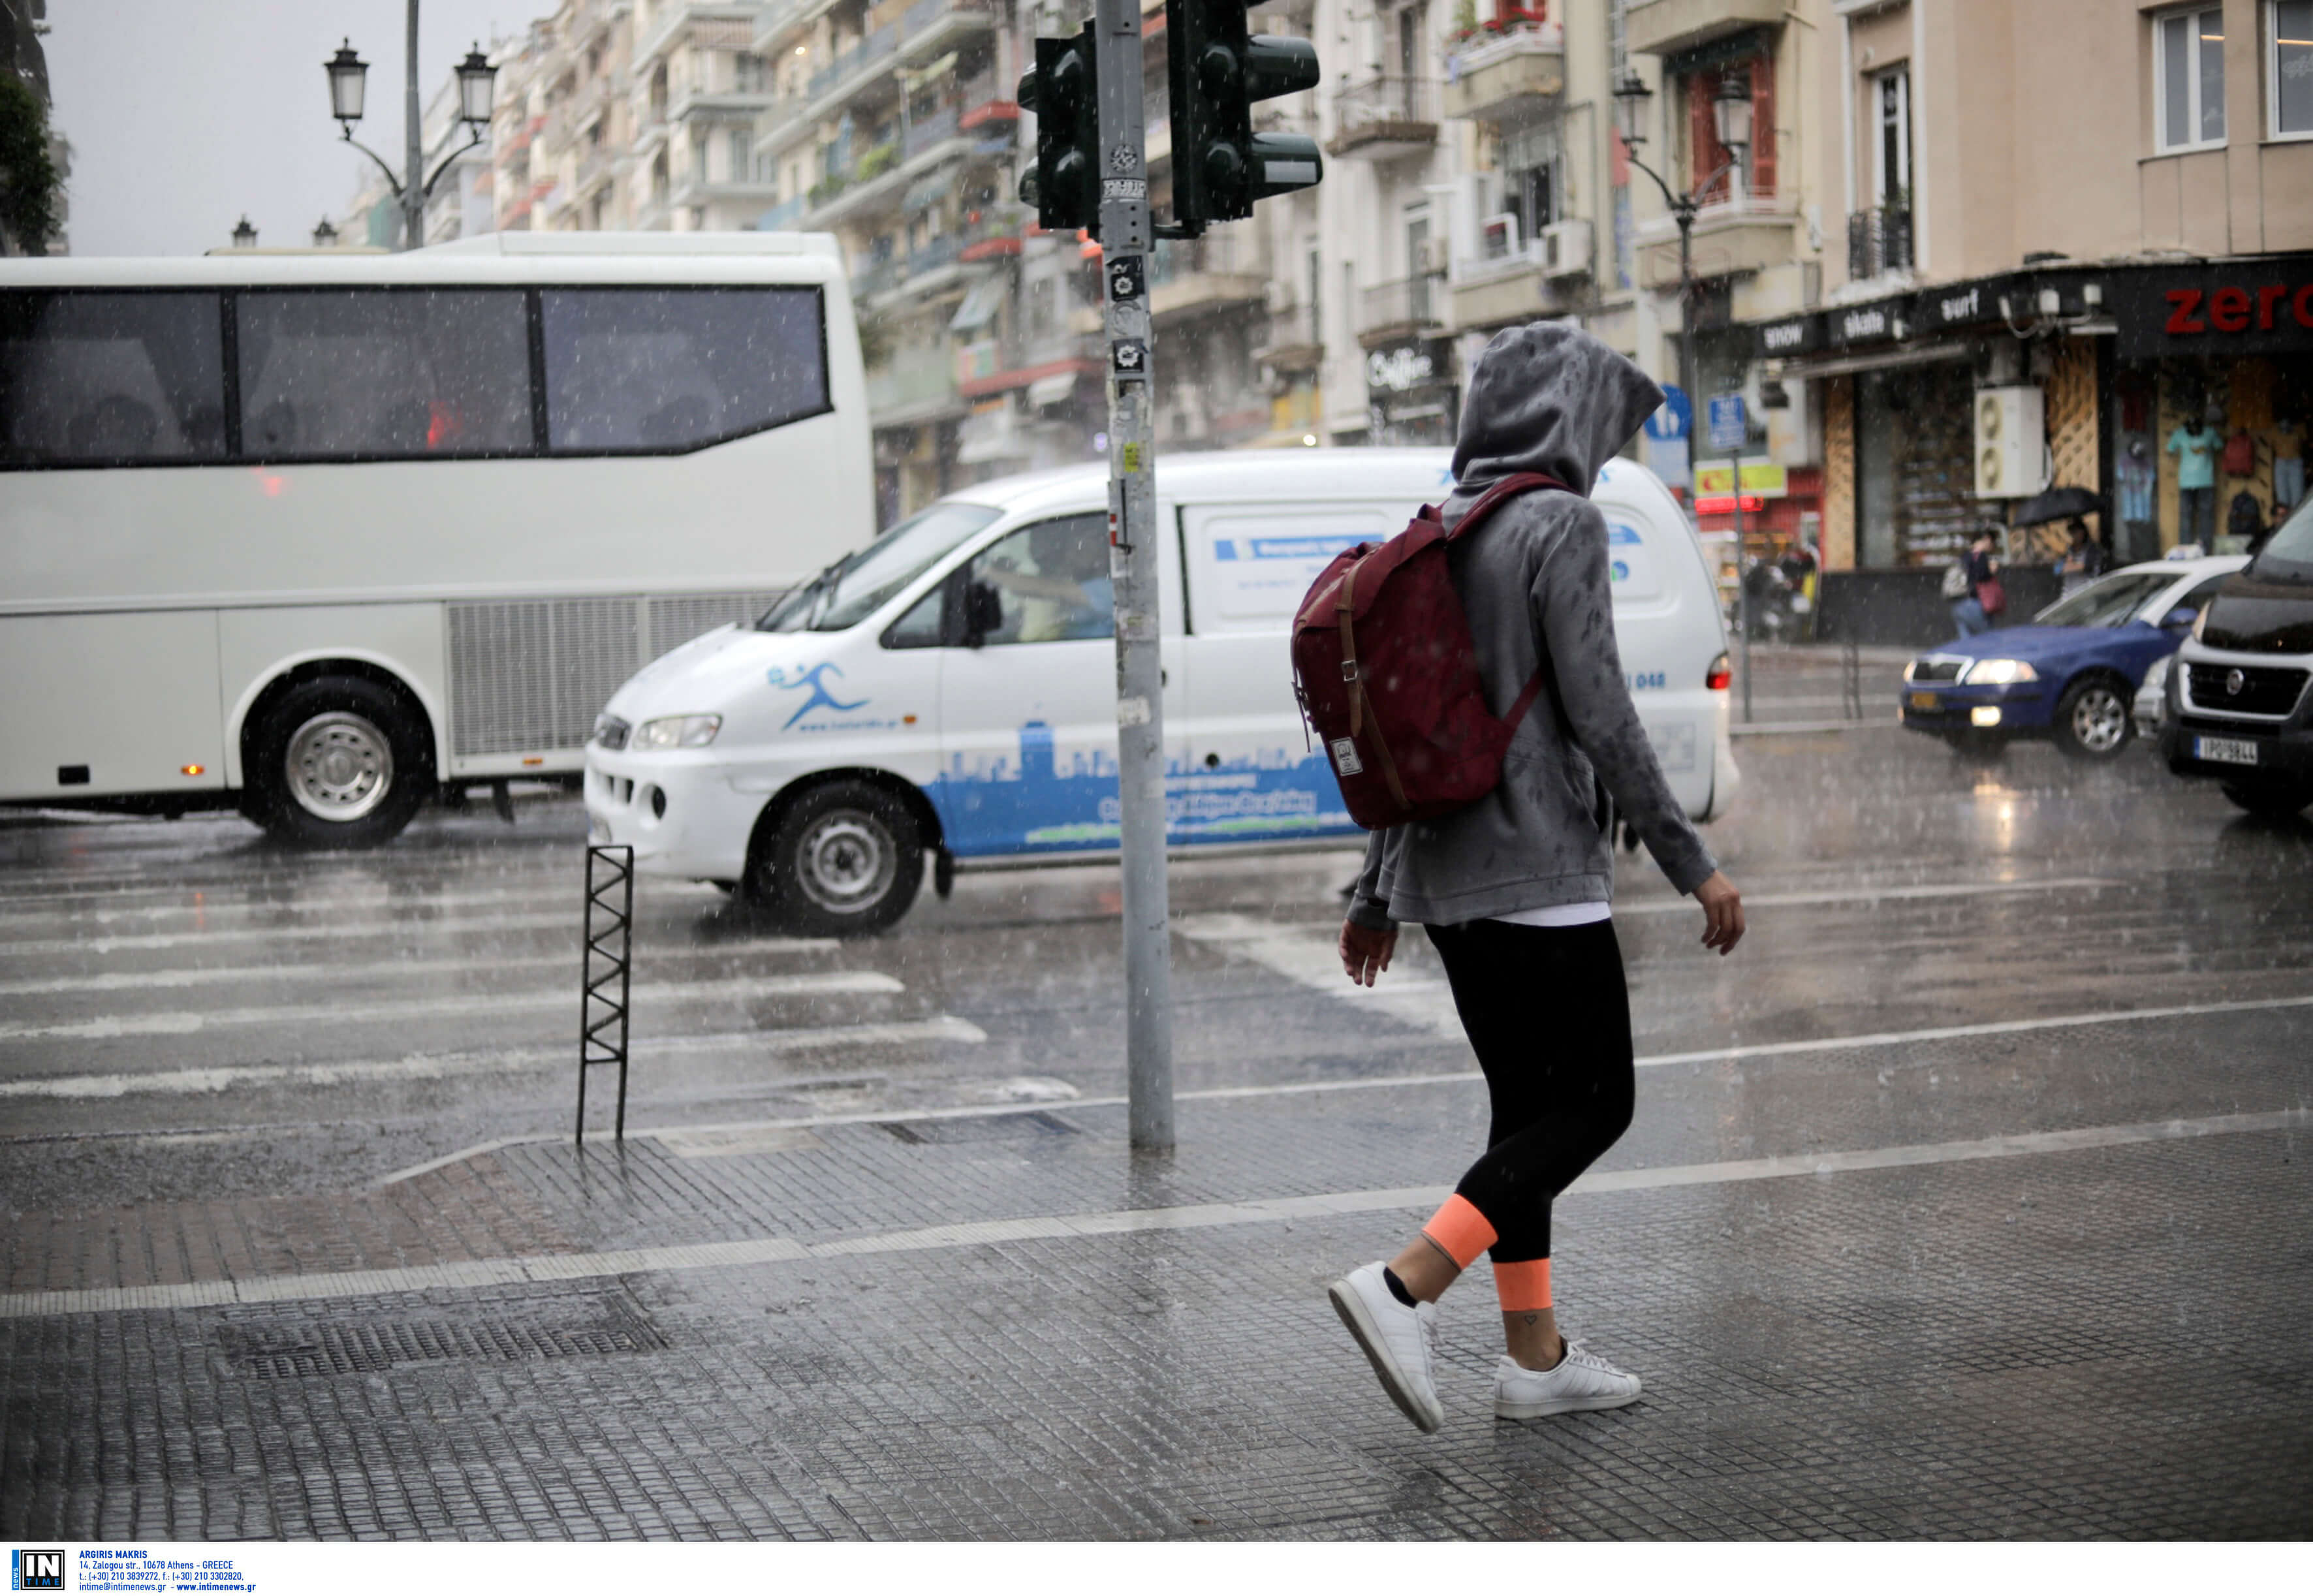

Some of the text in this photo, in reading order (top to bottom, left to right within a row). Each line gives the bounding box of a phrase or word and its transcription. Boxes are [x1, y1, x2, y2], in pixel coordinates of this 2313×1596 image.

[1941, 288, 1981, 322] surf
[1764, 324, 1803, 351] snow
[1844, 309, 1885, 339] skate
